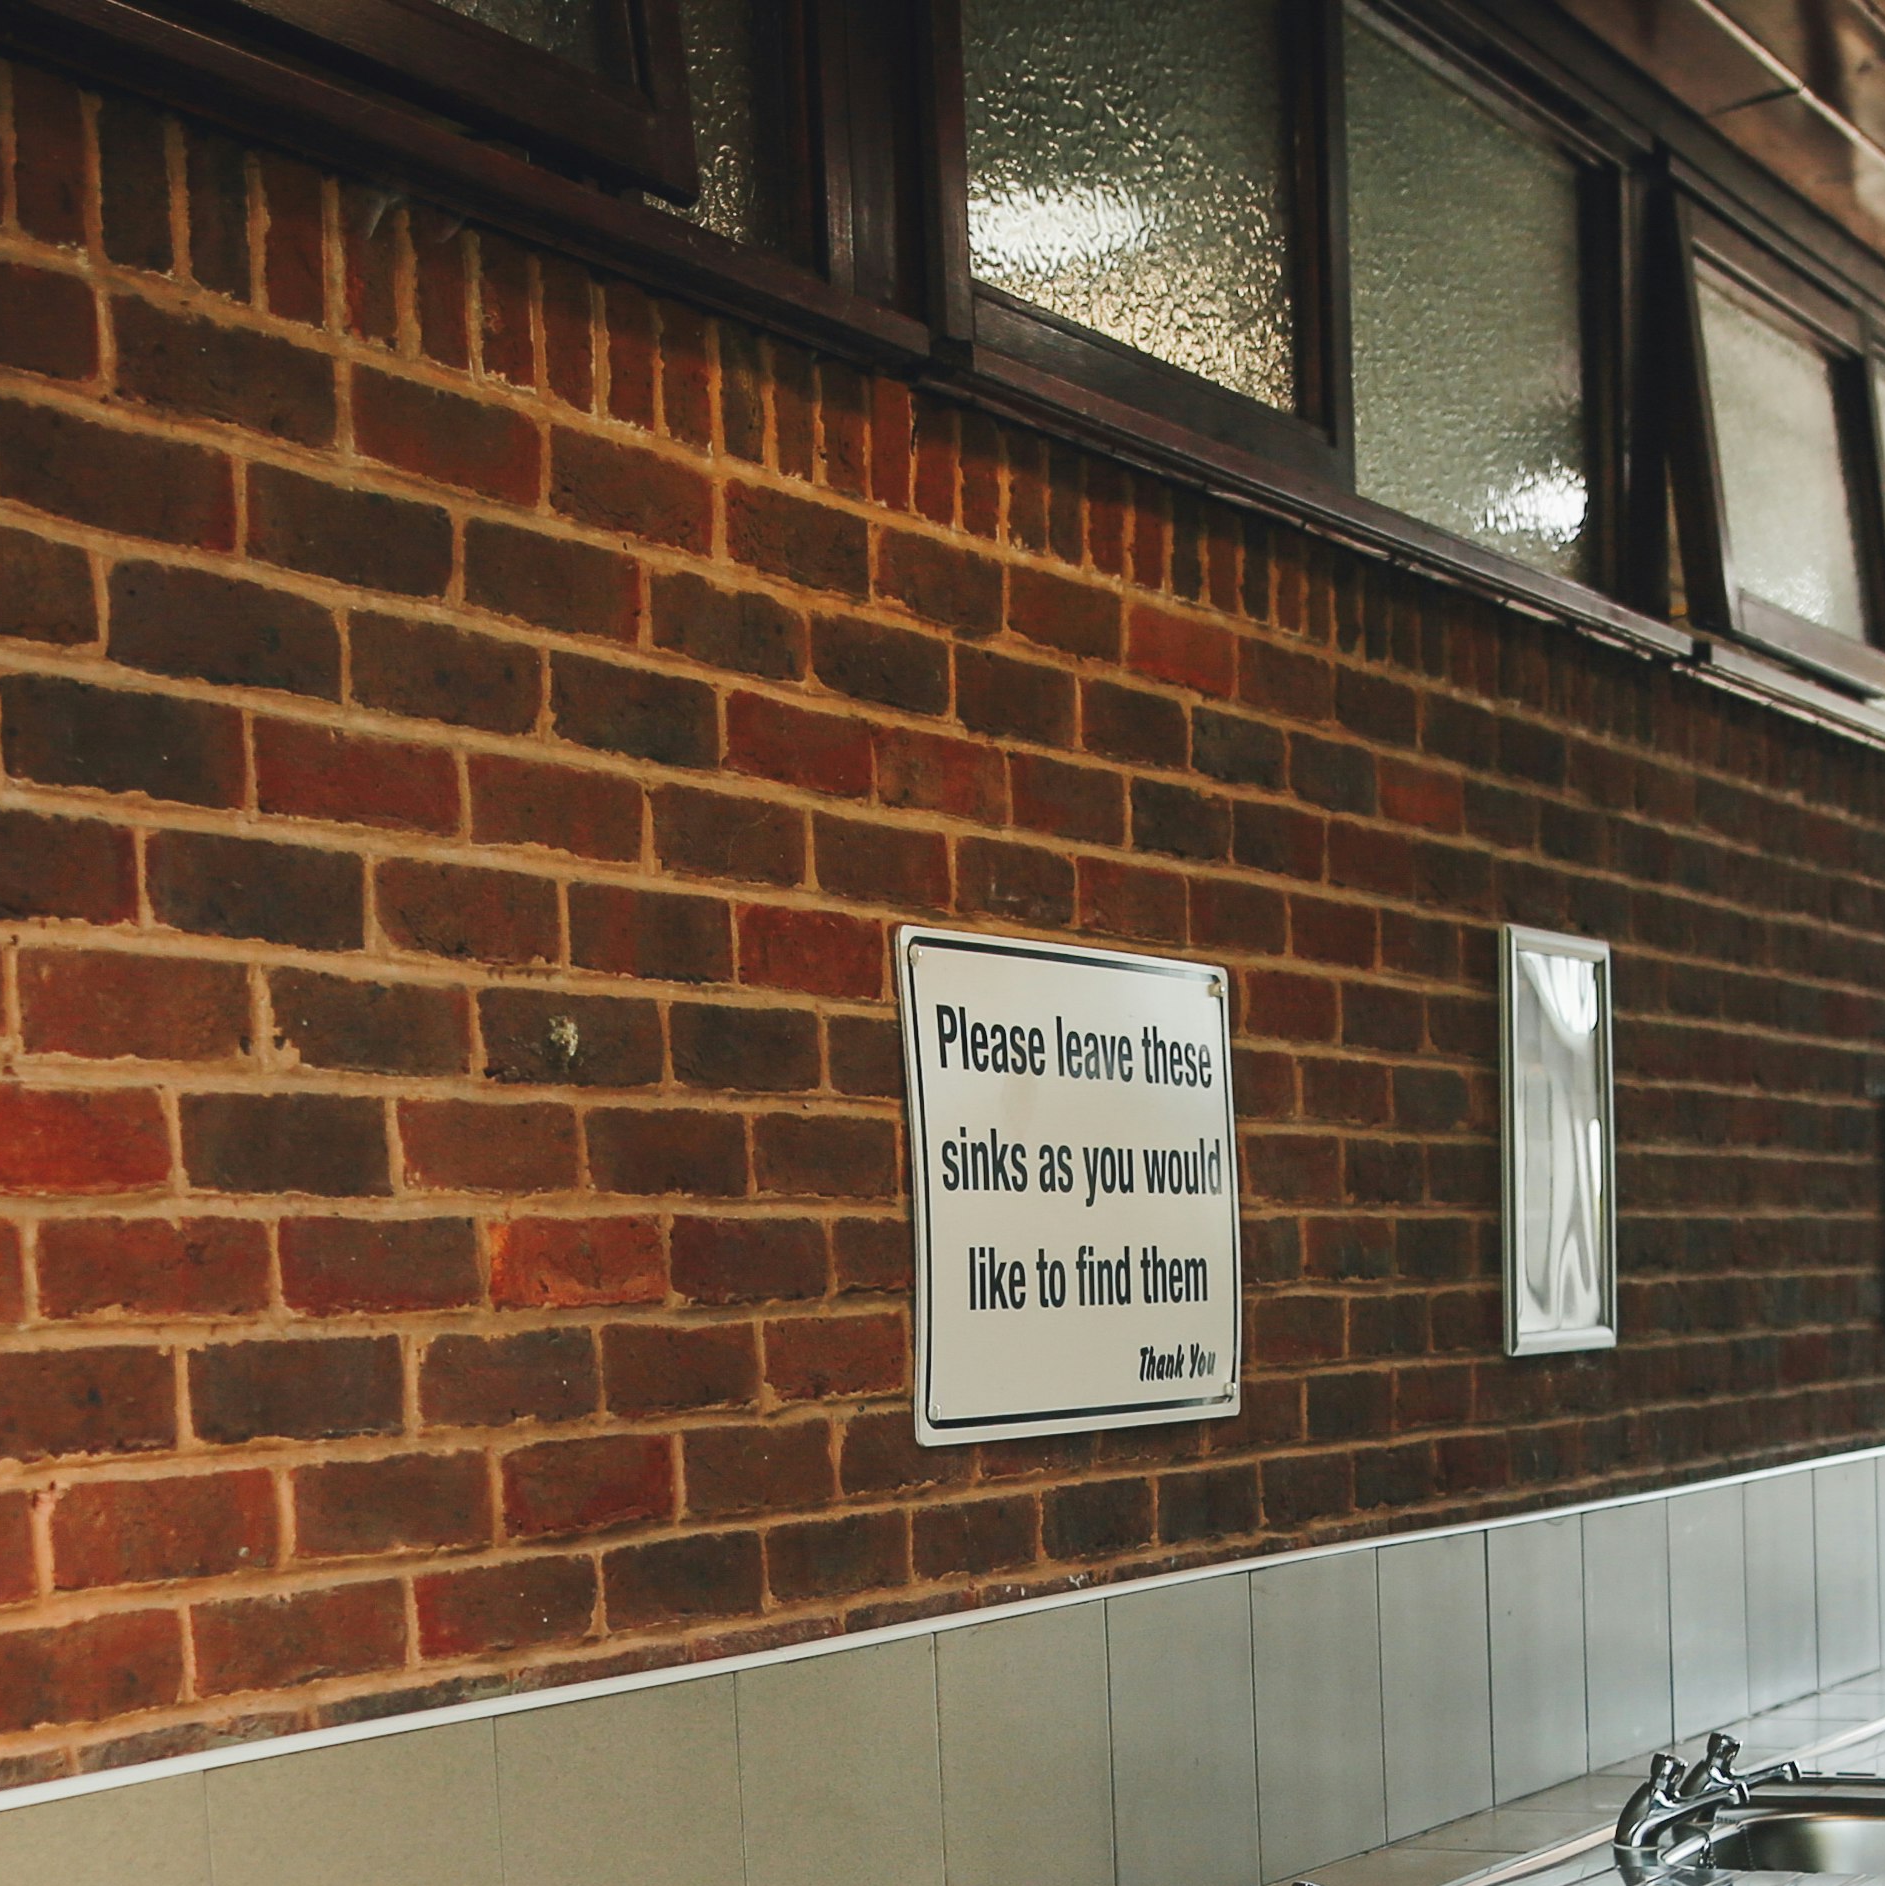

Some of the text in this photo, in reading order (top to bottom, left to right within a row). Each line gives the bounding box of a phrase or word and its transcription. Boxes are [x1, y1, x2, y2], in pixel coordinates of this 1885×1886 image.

[936, 1003, 1213, 1088] Please leave these
[941, 1126, 1223, 1208] sinks as you would
[969, 1245, 1208, 1310] like to find them
[1139, 1342, 1216, 1382] Thank You
